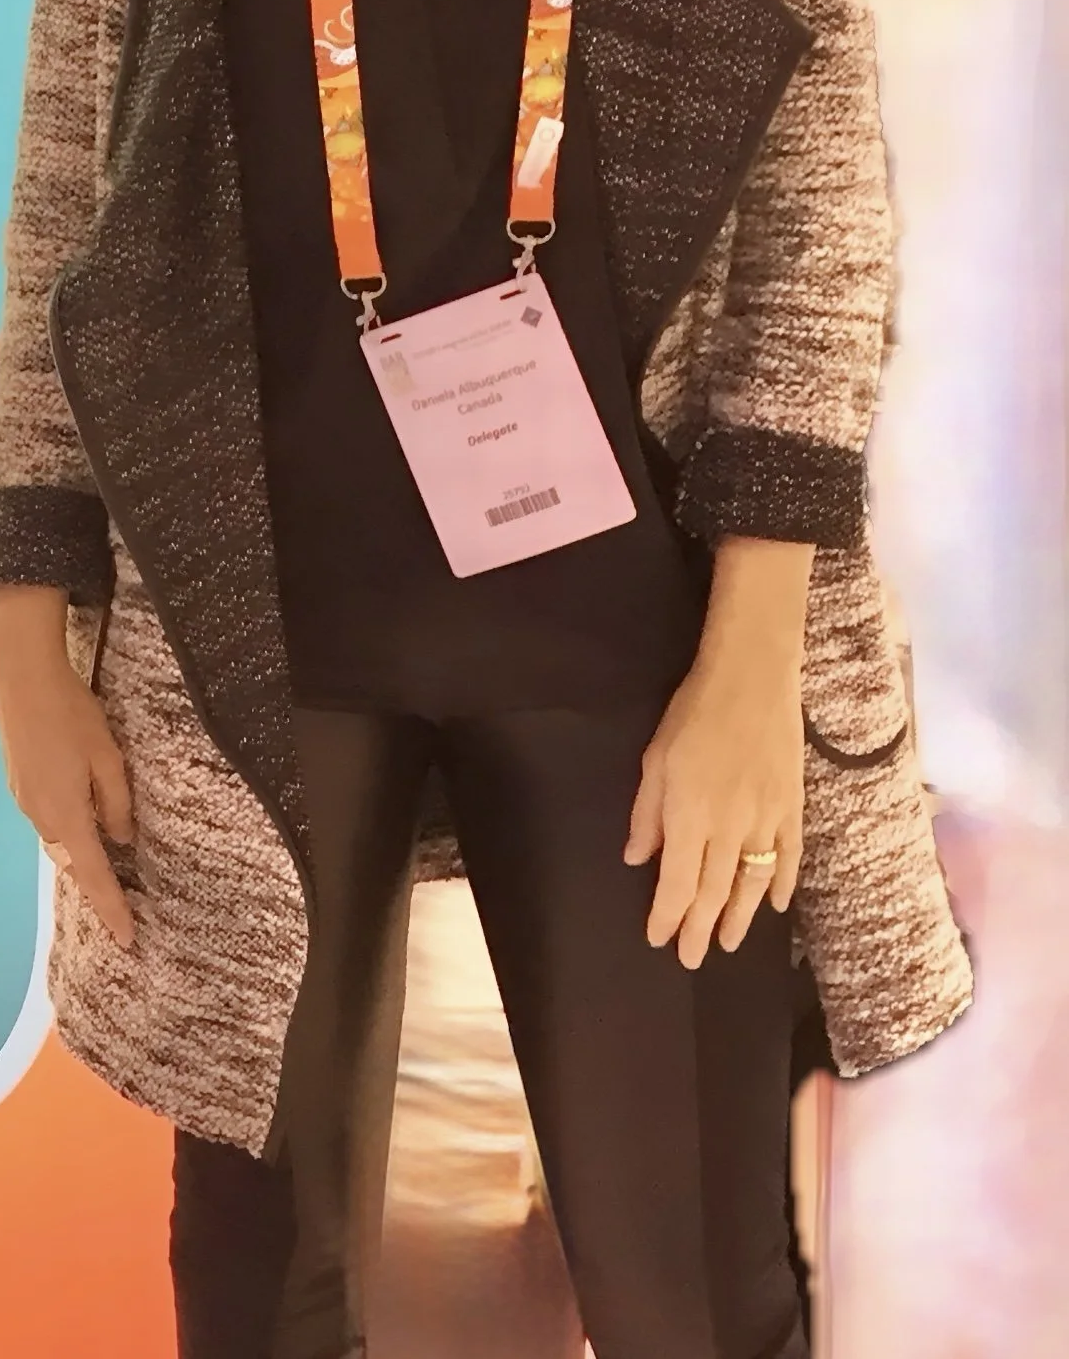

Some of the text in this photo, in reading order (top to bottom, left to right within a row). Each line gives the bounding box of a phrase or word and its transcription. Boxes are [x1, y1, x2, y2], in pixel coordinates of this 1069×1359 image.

[411, 360, 536, 411] Daniela Albuquerque
[457, 392, 503, 415] Canada
[467, 422, 518, 447] Delegate
